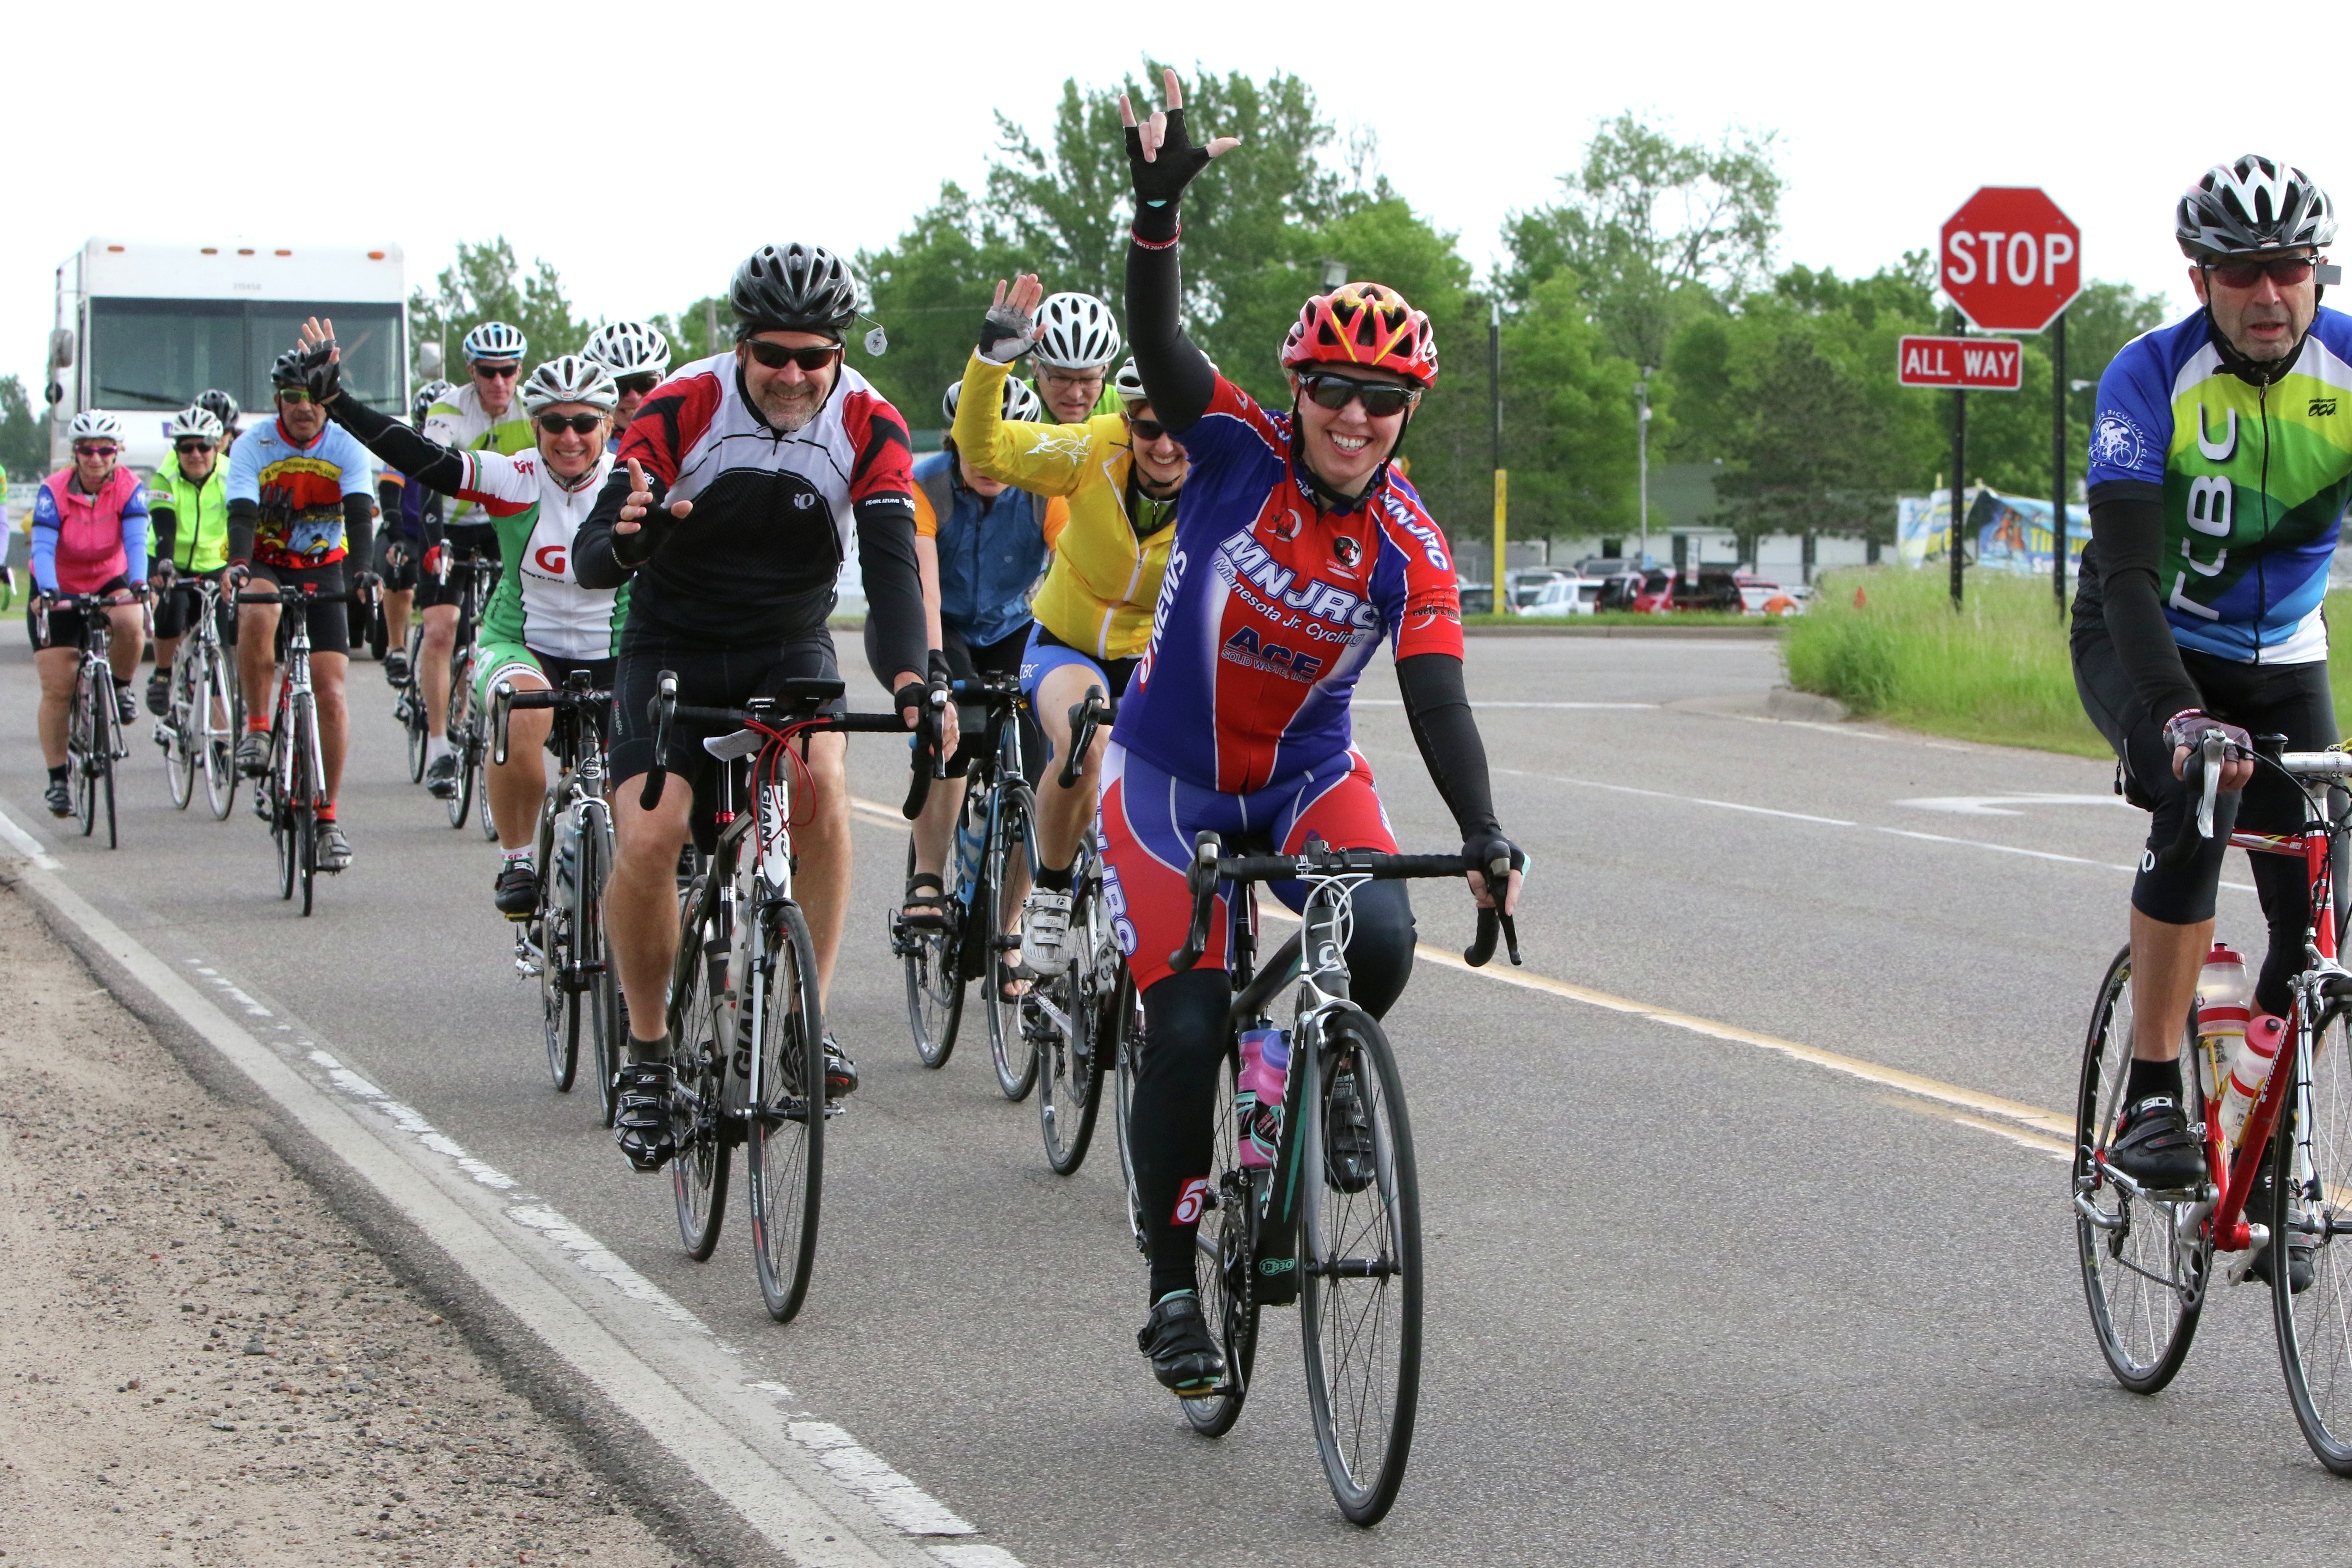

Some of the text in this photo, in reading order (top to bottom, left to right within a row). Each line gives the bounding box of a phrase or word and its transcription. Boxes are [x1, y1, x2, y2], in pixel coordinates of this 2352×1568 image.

[1136, 240, 1149, 249] 2015
[1948, 230, 2074, 286] STOP
[1905, 348, 2016, 378] ALL WAY
[1377, 493, 1450, 571] MNJRC
[2169, 401, 2236, 621] TCBC
[1151, 541, 1188, 655] NEWS
[1213, 557, 1366, 648] Minnesota Jr. Cycling
[1219, 528, 1381, 630] MNJRC
[1221, 649, 1253, 667] SOLID
[1224, 625, 1323, 679] ACE
[2175, 710, 2189, 718] 2015
[762, 785, 772, 857] GIANT
[2141, 1096, 2173, 1112] SIDI
[1176, 1178, 1209, 1222] 5
